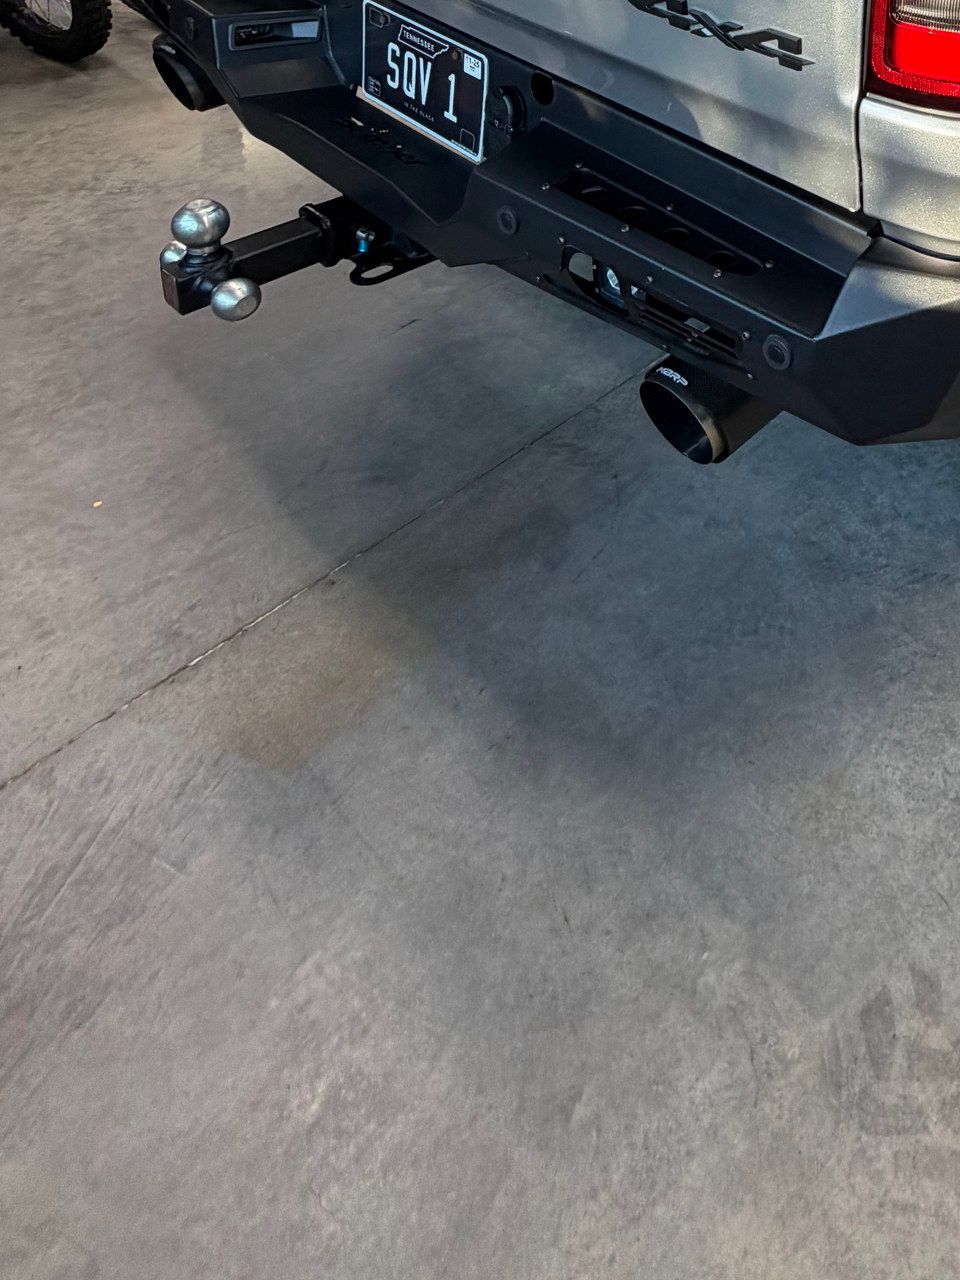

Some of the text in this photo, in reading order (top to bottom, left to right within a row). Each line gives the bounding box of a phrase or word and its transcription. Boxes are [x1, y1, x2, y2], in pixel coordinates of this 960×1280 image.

[403, 29, 435, 52] TENNESSEE
[387, 42, 458, 124] SQV 1
